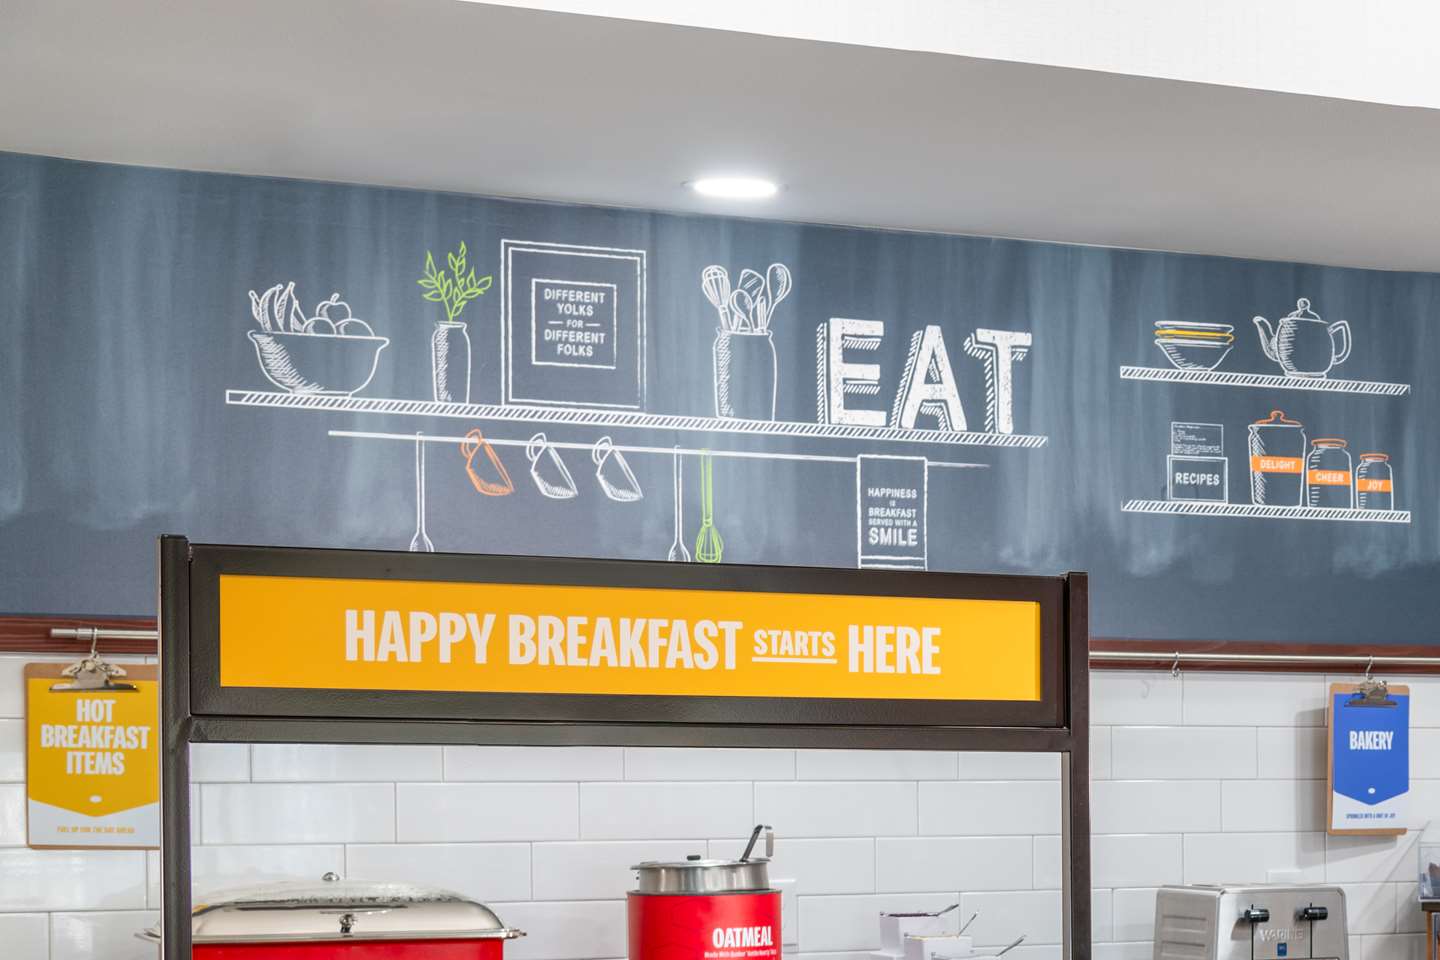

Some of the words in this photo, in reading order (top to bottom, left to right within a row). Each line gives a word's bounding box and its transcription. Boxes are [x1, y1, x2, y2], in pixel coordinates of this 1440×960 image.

[544, 288, 606, 304] DIFFERENT
[557, 303, 594, 317] YOLKS
[566, 319, 584, 329] FOR
[544, 329, 606, 345] DIFFERENT
[557, 343, 593, 357] FOLKS
[816, 317, 1033, 435] EAT
[1260, 459, 1296, 470] DELIGHT
[1175, 472, 1220, 486] RECIPES
[1315, 473, 1345, 483] CHEER
[868, 487, 918, 499] HAPPINESS
[1367, 481, 1384, 491] JOY
[868, 507, 917, 519] BREAKFAST
[868, 517, 893, 527] SERVED
[894, 518, 911, 528] WITH
[912, 519, 918, 527] A
[868, 527, 918, 546] SMILE
[345, 608, 496, 664] HAPPY
[508, 614, 742, 670] BREAKFAST
[753, 629, 836, 657] STARTS
[848, 624, 941, 675] HERE
[76, 699, 116, 723] HOT
[40, 723, 150, 749] BREAKFAST
[1349, 730, 1394, 750] BAKERY
[66, 751, 125, 775] ITEMS
[712, 926, 773, 949] OATMEAL
